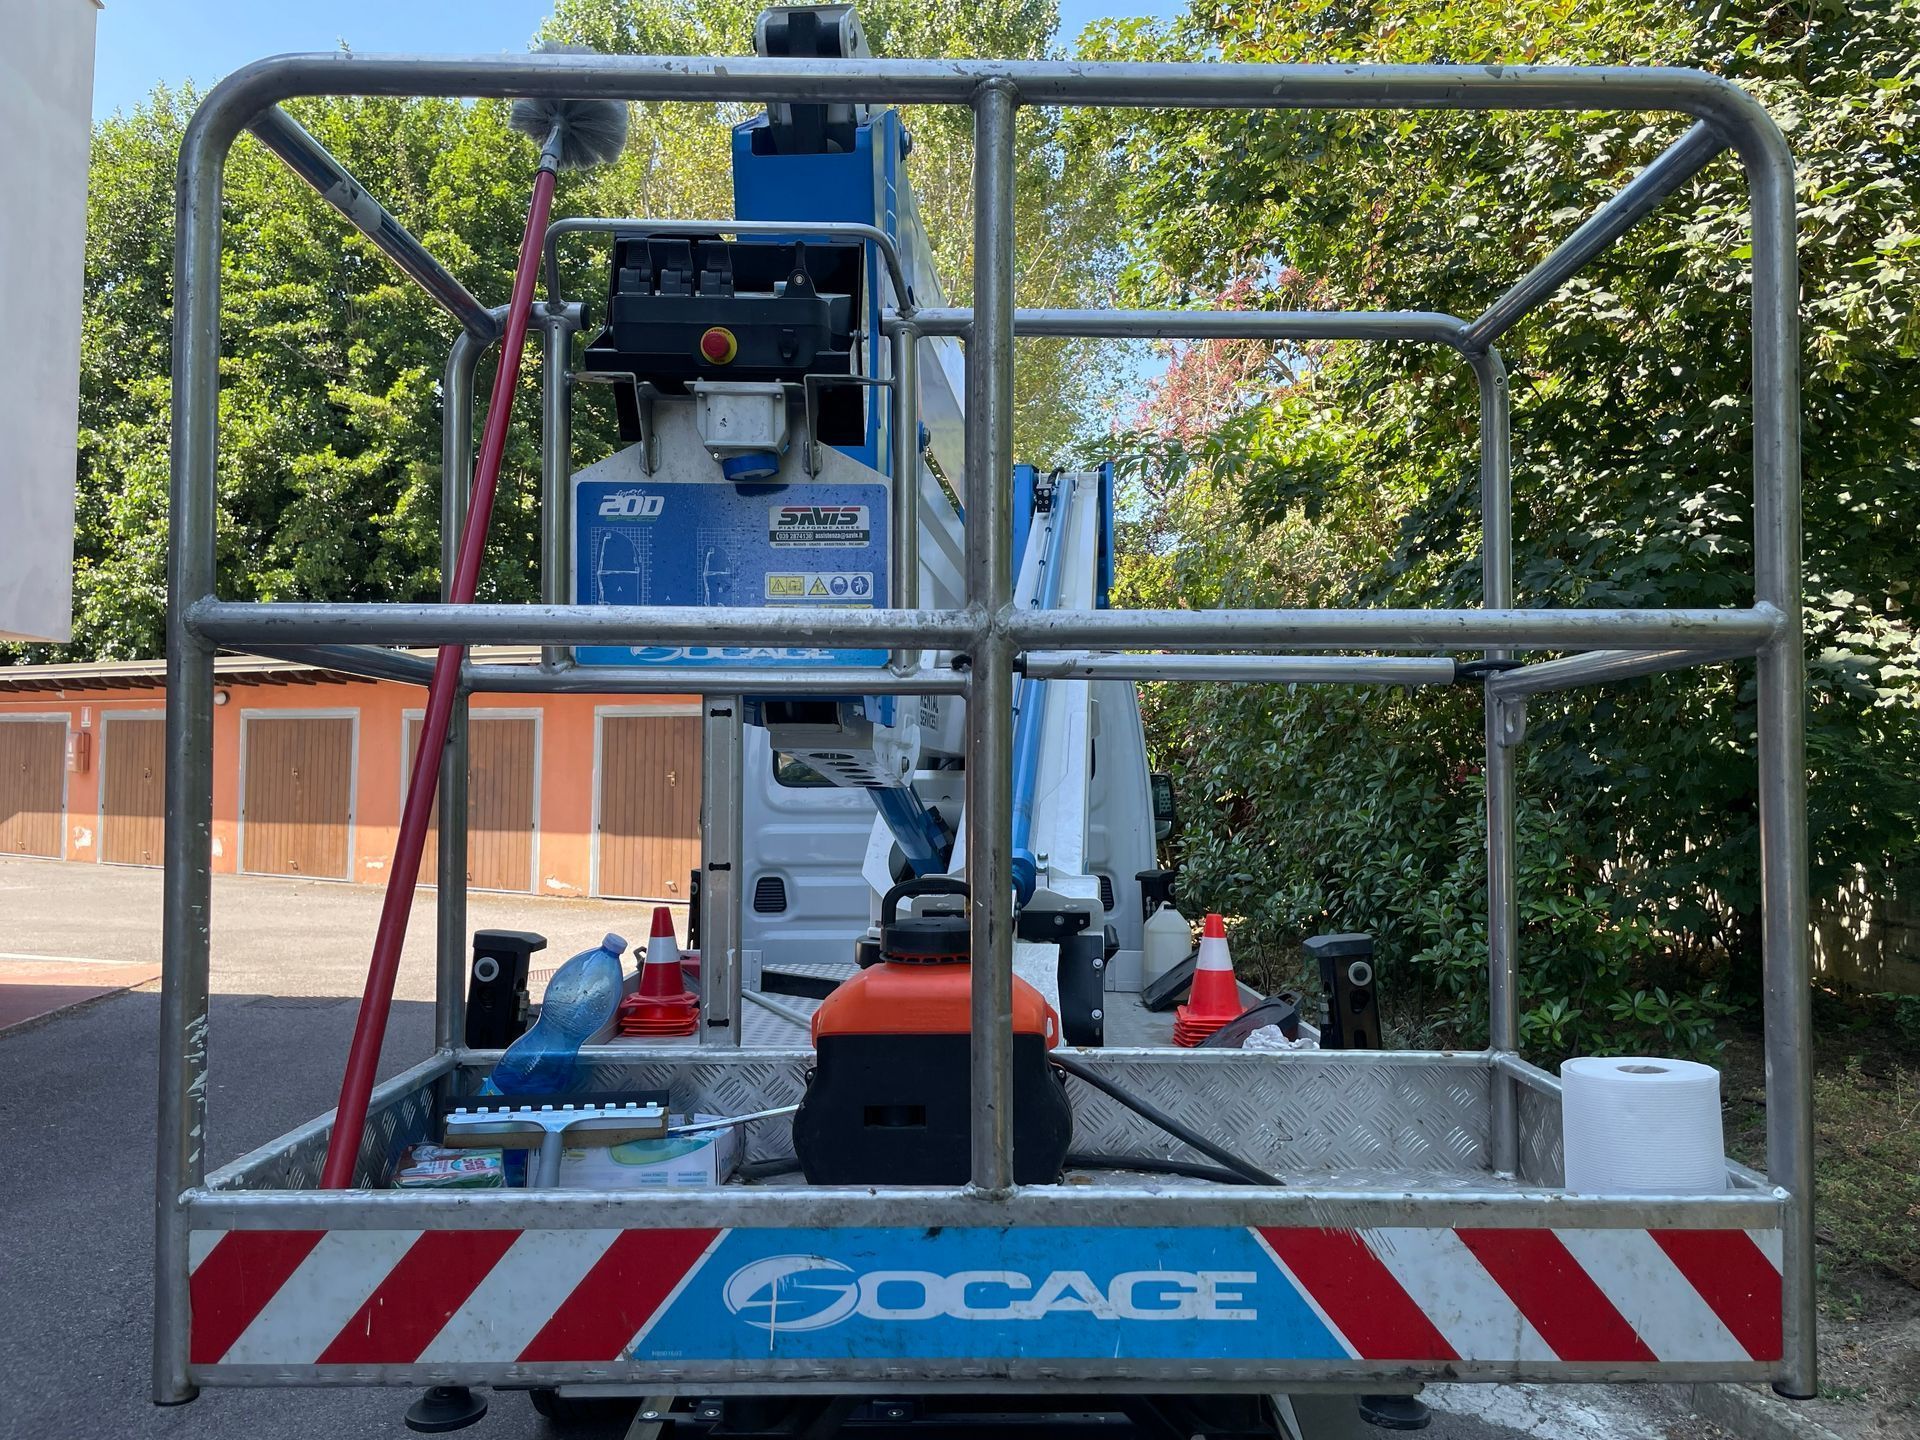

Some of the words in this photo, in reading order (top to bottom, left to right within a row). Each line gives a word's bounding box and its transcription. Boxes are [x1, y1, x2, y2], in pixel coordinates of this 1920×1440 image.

[598, 495, 664, 516] 20D
[777, 507, 861, 525] SAVIS
[723, 1254, 1257, 1331] SOCAGE
